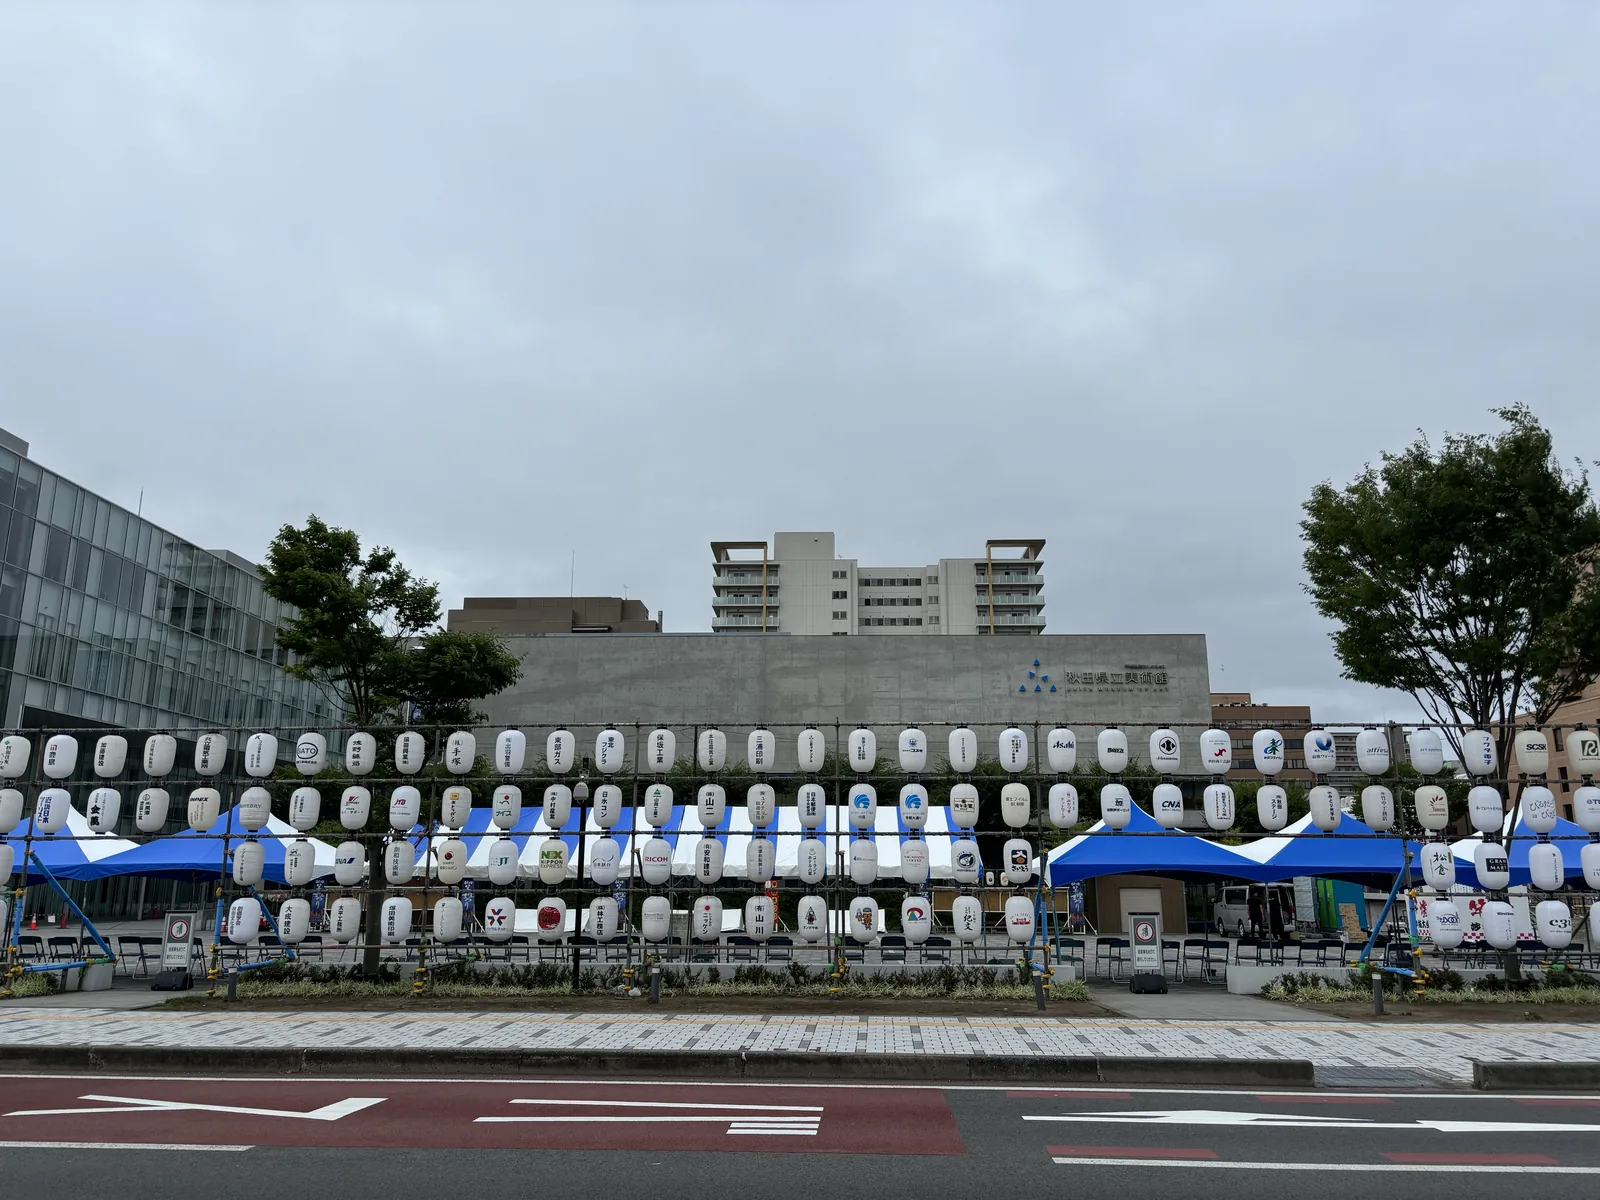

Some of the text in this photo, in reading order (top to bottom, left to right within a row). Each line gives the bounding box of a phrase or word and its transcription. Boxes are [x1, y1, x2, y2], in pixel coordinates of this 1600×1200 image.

[1066, 671, 1168, 684] 秋田県立美術館
[554, 737, 562, 765] 東部ガス
[1053, 740, 1074, 749] Asahi
[1483, 737, 1491, 765] フクダ電子
[1162, 800, 1181, 808] CNA
[284, 905, 293, 935] 大成建設
